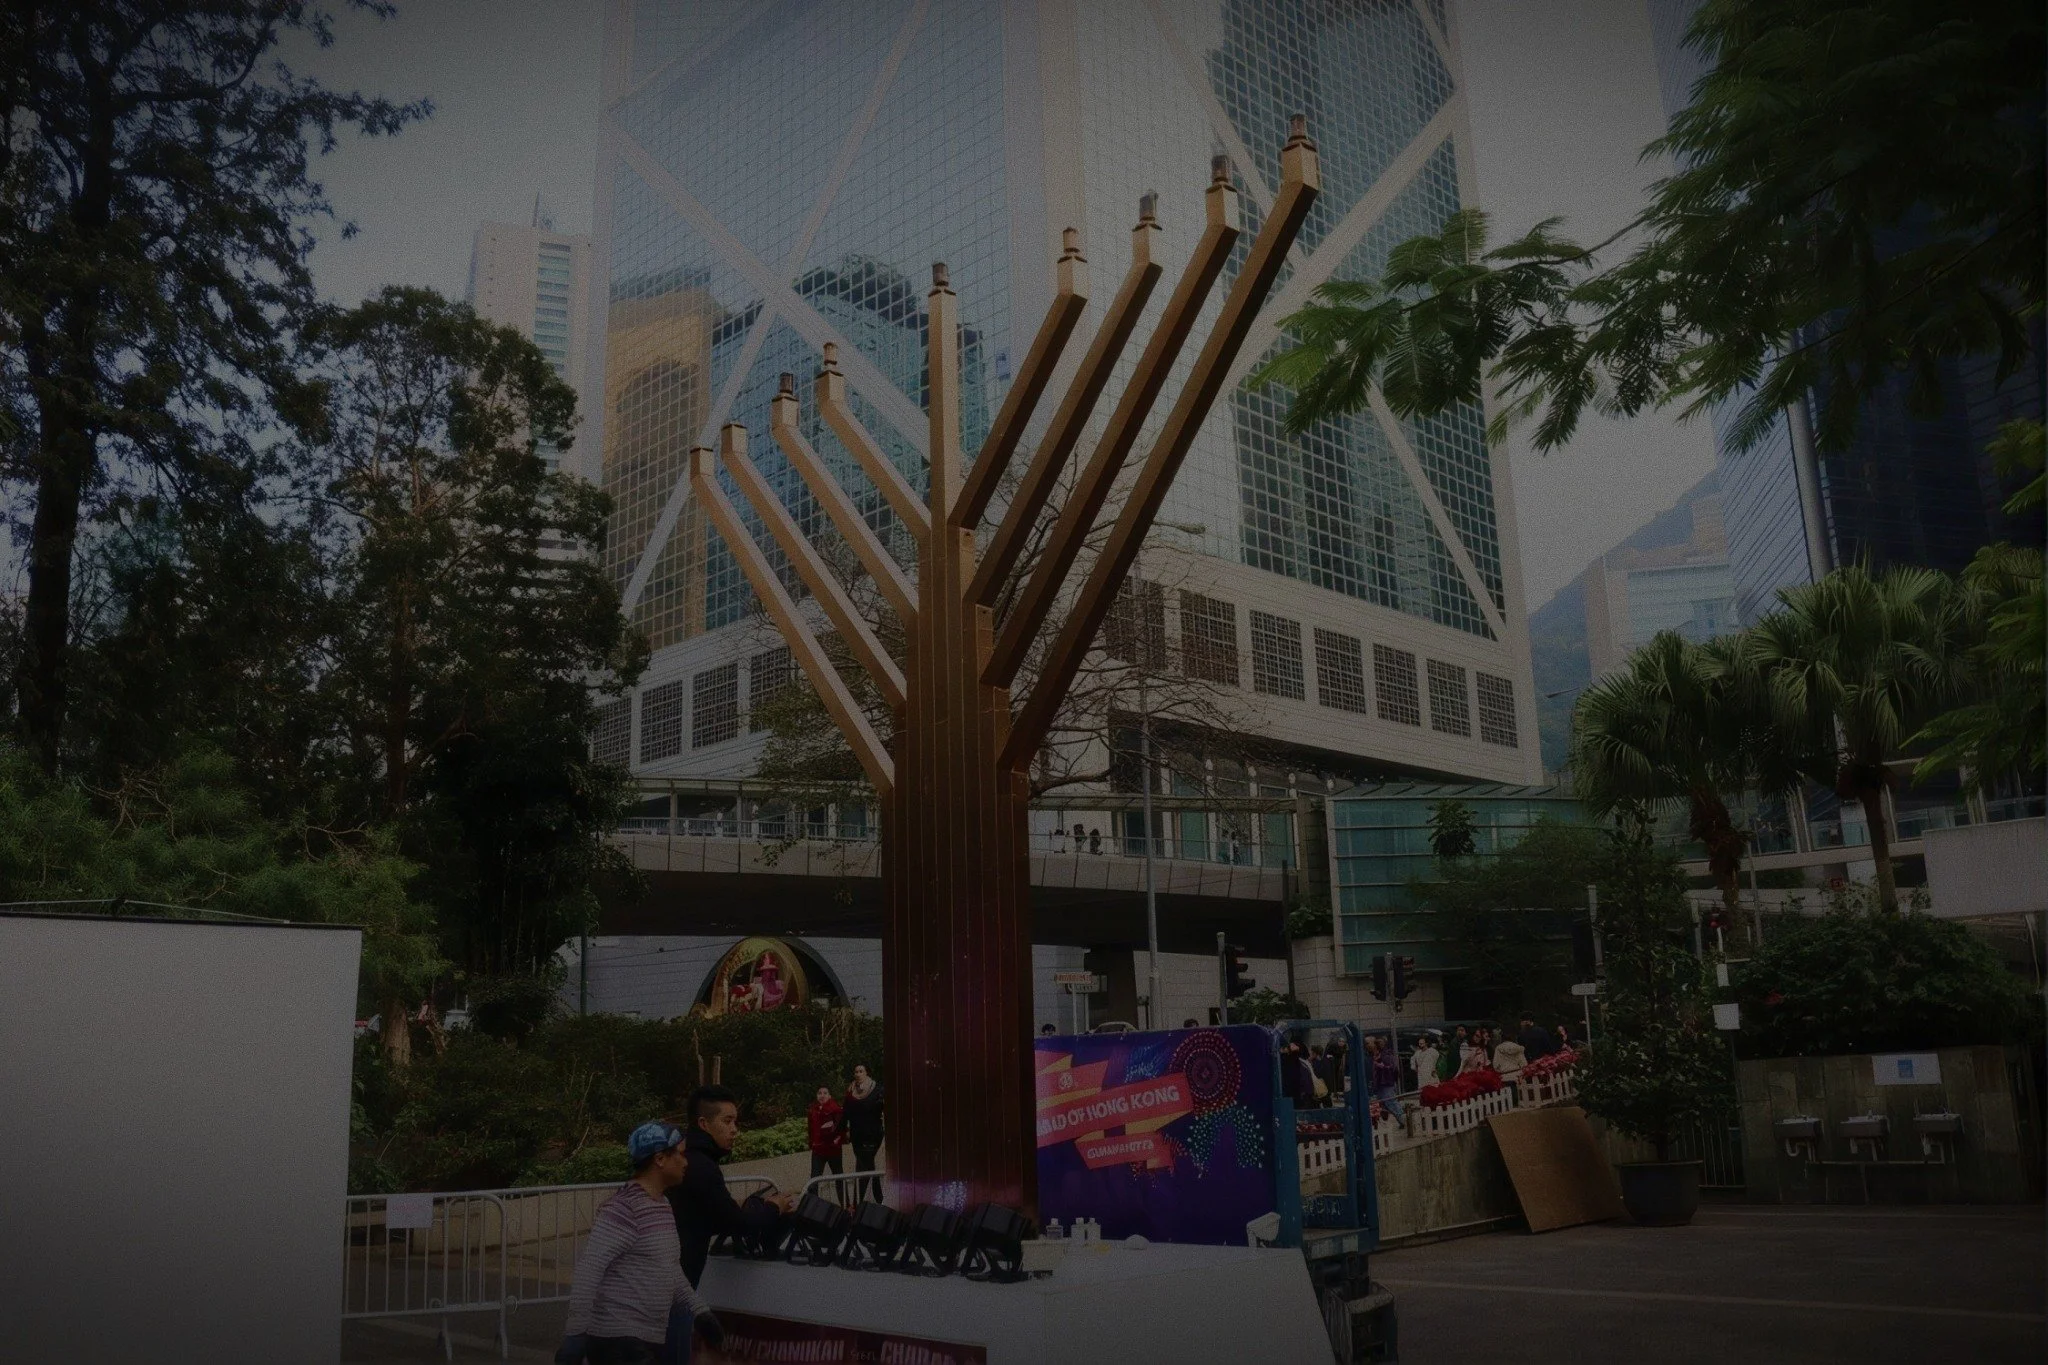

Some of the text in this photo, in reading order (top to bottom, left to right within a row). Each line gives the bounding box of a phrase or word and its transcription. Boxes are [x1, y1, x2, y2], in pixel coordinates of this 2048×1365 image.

[1068, 1107, 1084, 1125] OF
[1085, 1097, 1129, 1121] HONG
[1130, 1085, 1180, 1108] KONG
